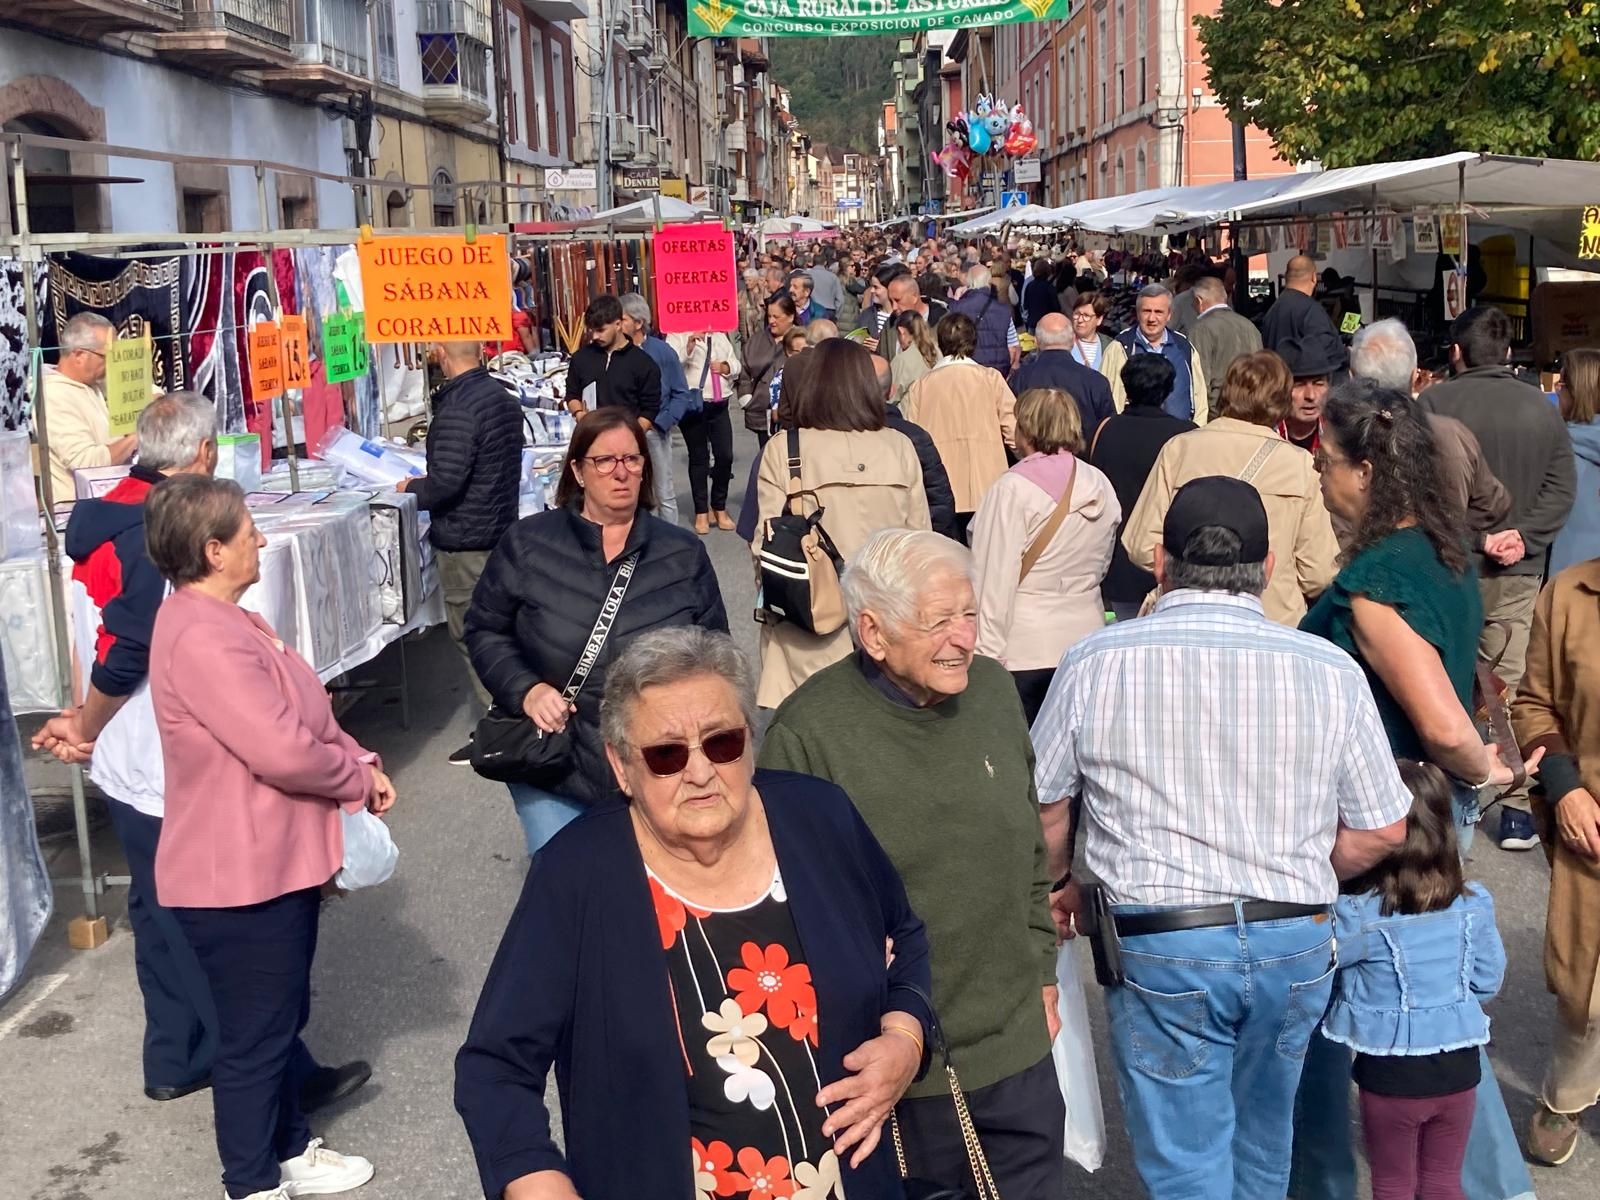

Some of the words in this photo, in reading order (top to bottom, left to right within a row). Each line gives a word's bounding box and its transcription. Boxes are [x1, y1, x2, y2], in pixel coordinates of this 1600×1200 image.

[743, 0, 794, 18] CAJA
[797, 0, 867, 17] RURAL
[870, 0, 899, 15] DE
[903, 0, 1010, 14] ASTU
[742, 22, 824, 32] CONCURSO
[831, 18, 920, 32] EXPOSICIÓN
[927, 17, 945, 27] DE
[952, 9, 1014, 25] GANADO
[624, 177, 659, 187] DENVER
[1585, 207, 1600, 224] A
[374, 247, 453, 266] JUEGO
[462, 246, 494, 264] DE
[662, 240, 726, 254] OFERTAS
[664, 270, 728, 285] OFERTAS
[383, 277, 491, 301] SÁBANA
[666, 299, 730, 314] OFERTAS
[377, 316, 504, 336] CORALINA
[562, 685, 580, 702] LA
[576, 633, 605, 677] BIMBA
[596, 620, 608, 631] Y
[602, 586, 625, 620] LOLA
[619, 551, 639, 578] BIM
